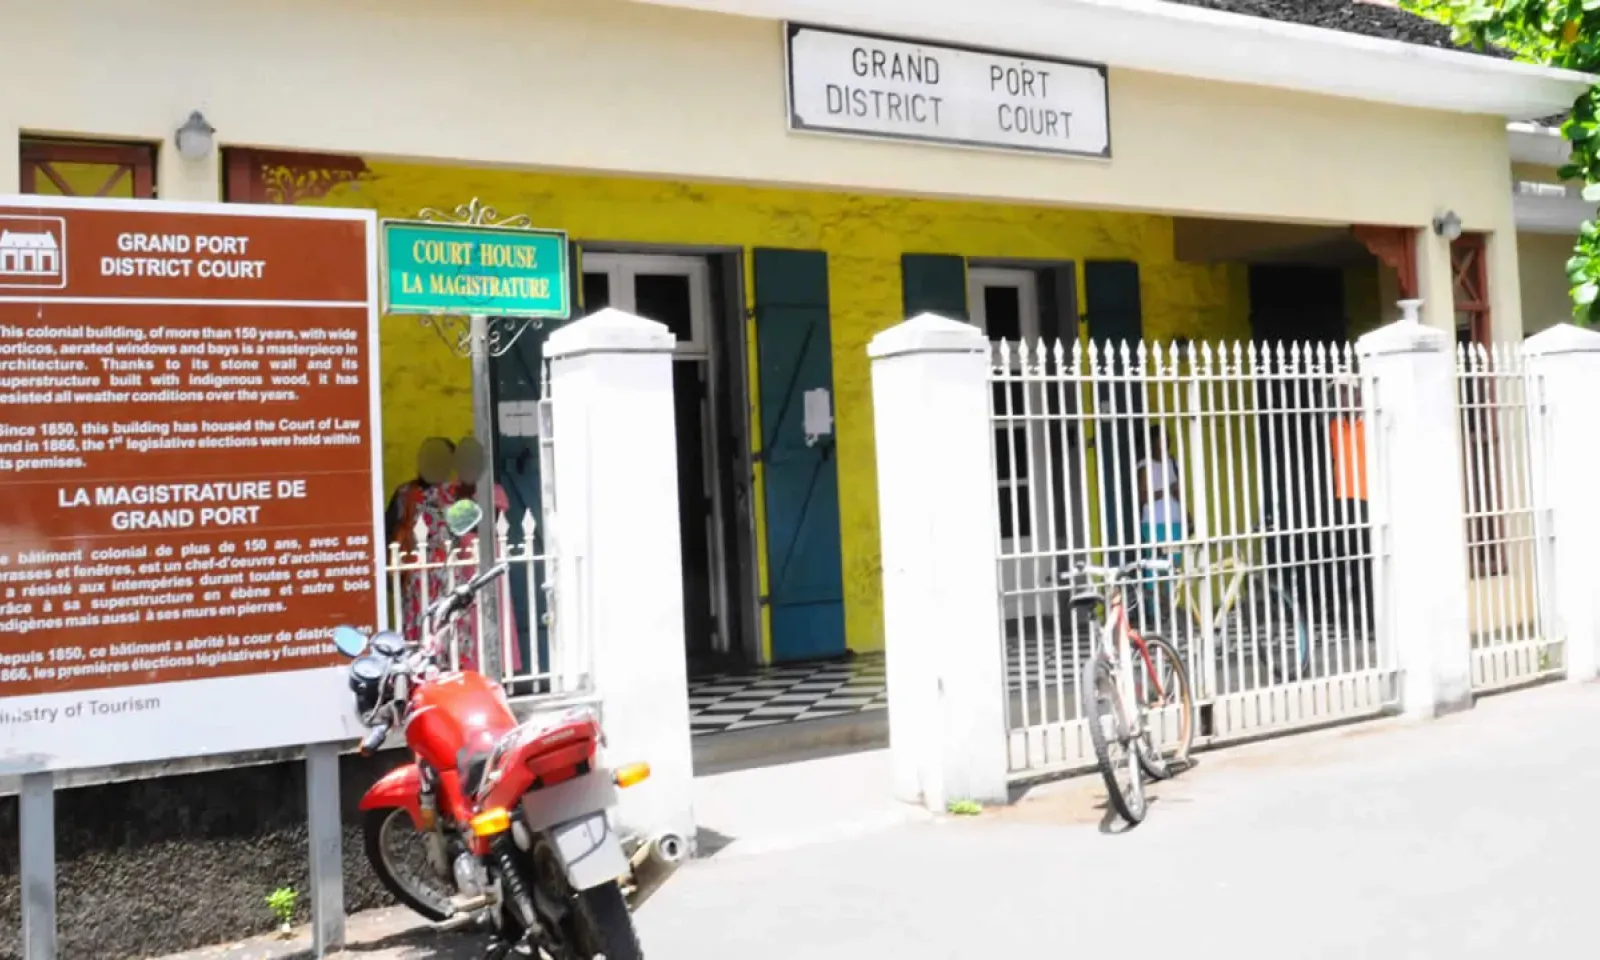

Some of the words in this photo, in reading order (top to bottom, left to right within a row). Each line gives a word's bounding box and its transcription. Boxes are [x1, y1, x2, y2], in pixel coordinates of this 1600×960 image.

[852, 47, 940, 85] GRAND
[990, 65, 1050, 98] PORT
[826, 84, 942, 125] DISTRICT
[998, 103, 1072, 138] COURT
[117, 233, 190, 252] GRAND
[195, 235, 248, 253] PORT
[412, 239, 473, 265] COURT
[480, 244, 537, 269] HOUSE
[101, 257, 191, 276] DISTRICT
[197, 259, 265, 277] COURT
[401, 272, 423, 294] LA
[430, 274, 550, 299] MAGISTRATURE
[25, 325, 84, 337] colonial
[148, 326, 164, 338] of
[164, 328, 200, 338] more
[201, 327, 232, 338] than
[234, 327, 258, 338] 150
[299, 328, 326, 338] with
[326, 328, 357, 339] wide
[59, 342, 113, 354] aerated
[115, 342, 177, 354] windows
[179, 342, 205, 354] and
[206, 343, 239, 356] bays
[241, 343, 254, 353] is
[255, 345, 264, 354] a
[265, 343, 344, 356] masterpiece
[345, 343, 357, 353] in
[101, 357, 154, 370] Thanks
[165, 359, 180, 369] to
[191, 358, 209, 369] its
[220, 359, 259, 369] stone
[269, 358, 296, 369] wall
[307, 358, 332, 369] and
[341, 359, 358, 369] its
[109, 373, 141, 385] built
[149, 373, 179, 385] with
[188, 373, 262, 388] indigenous
[318, 373, 327, 384] it
[335, 373, 358, 384] has
[0, 391, 53, 403] esisted
[53, 390, 72, 402] all
[73, 390, 130, 402] weather
[131, 389, 204, 401] conditions
[205, 390, 235, 400] over
[237, 389, 258, 400] the
[81, 422, 109, 434] this
[112, 421, 170, 435] building
[173, 421, 198, 432] has
[201, 419, 251, 432] housed
[253, 419, 275, 430] the
[278, 419, 314, 430] Court
[317, 418, 330, 429] of
[334, 419, 359, 429] Law
[24, 440, 39, 452] in
[81, 438, 104, 450] the
[107, 436, 122, 448] 1st
[126, 436, 196, 451] legislative
[197, 436, 258, 447] elections
[259, 436, 291, 445] were
[292, 433, 321, 444] held
[321, 433, 360, 444] within
[58, 488, 91, 506] LA
[95, 483, 271, 504] MAGISTRATURE
[277, 479, 306, 497] DE
[111, 508, 194, 529] GRAND
[200, 505, 260, 524] PORT
[90, 546, 147, 559] colonial
[154, 544, 173, 556] de
[180, 543, 210, 557] plus
[218, 541, 235, 552] de
[244, 539, 266, 551] 150
[309, 537, 339, 547] avec
[346, 535, 368, 545] ses
[55, 566, 72, 578] et
[138, 562, 160, 573] est
[163, 562, 181, 572] un
[5, 587, 15, 597] a
[78, 582, 105, 593] aux
[199, 572, 243, 585] durant
[249, 569, 290, 581] toutes
[296, 568, 319, 578] ces
[0, 601, 32, 615] râce
[42, 599, 52, 612] à
[62, 599, 80, 610] sa
[90, 592, 194, 609] superstructure
[203, 590, 220, 600] en
[279, 584, 293, 595] et
[301, 582, 334, 593] autre
[343, 579, 370, 591] bois
[64, 613, 100, 626] mais
[100, 610, 140, 624] aussi
[145, 609, 154, 620] à
[155, 609, 181, 620] ses
[181, 607, 218, 617] murs
[217, 605, 236, 615] en
[0, 651, 44, 665] epuis
[89, 647, 106, 657] ce
[173, 641, 183, 650] a
[227, 635, 240, 645] la
[242, 634, 272, 644] cour
[275, 631, 292, 642] de
[294, 626, 338, 640] distric
[0, 667, 31, 681] 866,
[33, 667, 55, 678] les
[272, 649, 280, 660] y
[281, 643, 323, 656] furent
[64, 702, 83, 717] of
[89, 697, 160, 714] Tourism
